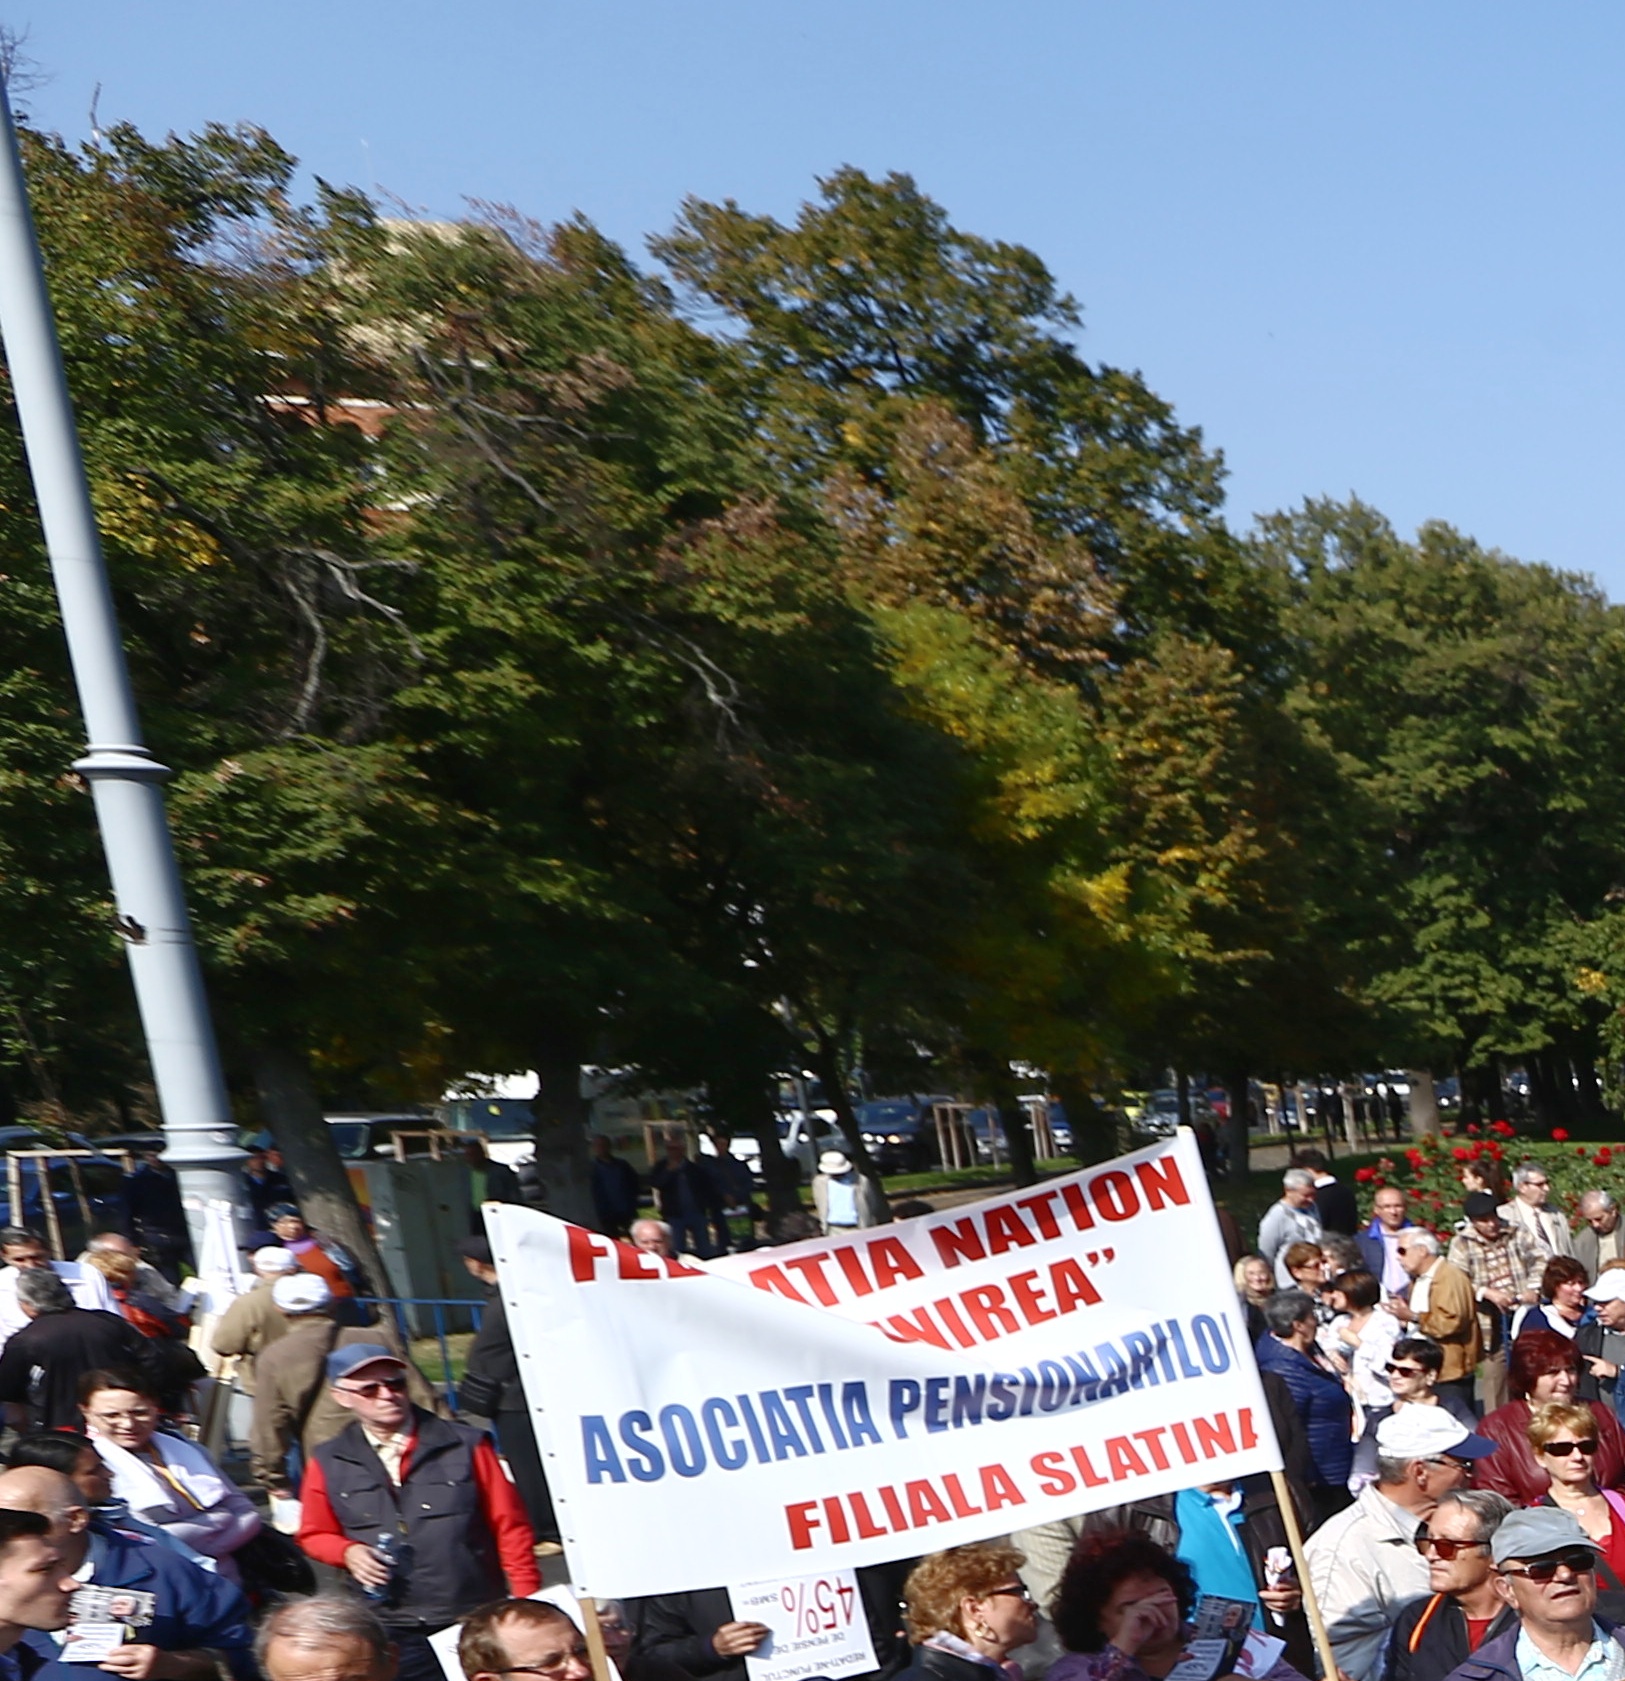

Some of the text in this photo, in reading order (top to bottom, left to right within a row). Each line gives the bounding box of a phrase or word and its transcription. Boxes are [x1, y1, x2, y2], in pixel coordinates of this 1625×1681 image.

[932, 1154, 1192, 1270] NATION
[581, 1312, 1242, 1484] ASOCIATIA PENSIONARILO
[784, 1463, 1026, 1550] FILIALA
[780, 1576, 855, 1638] 45%
